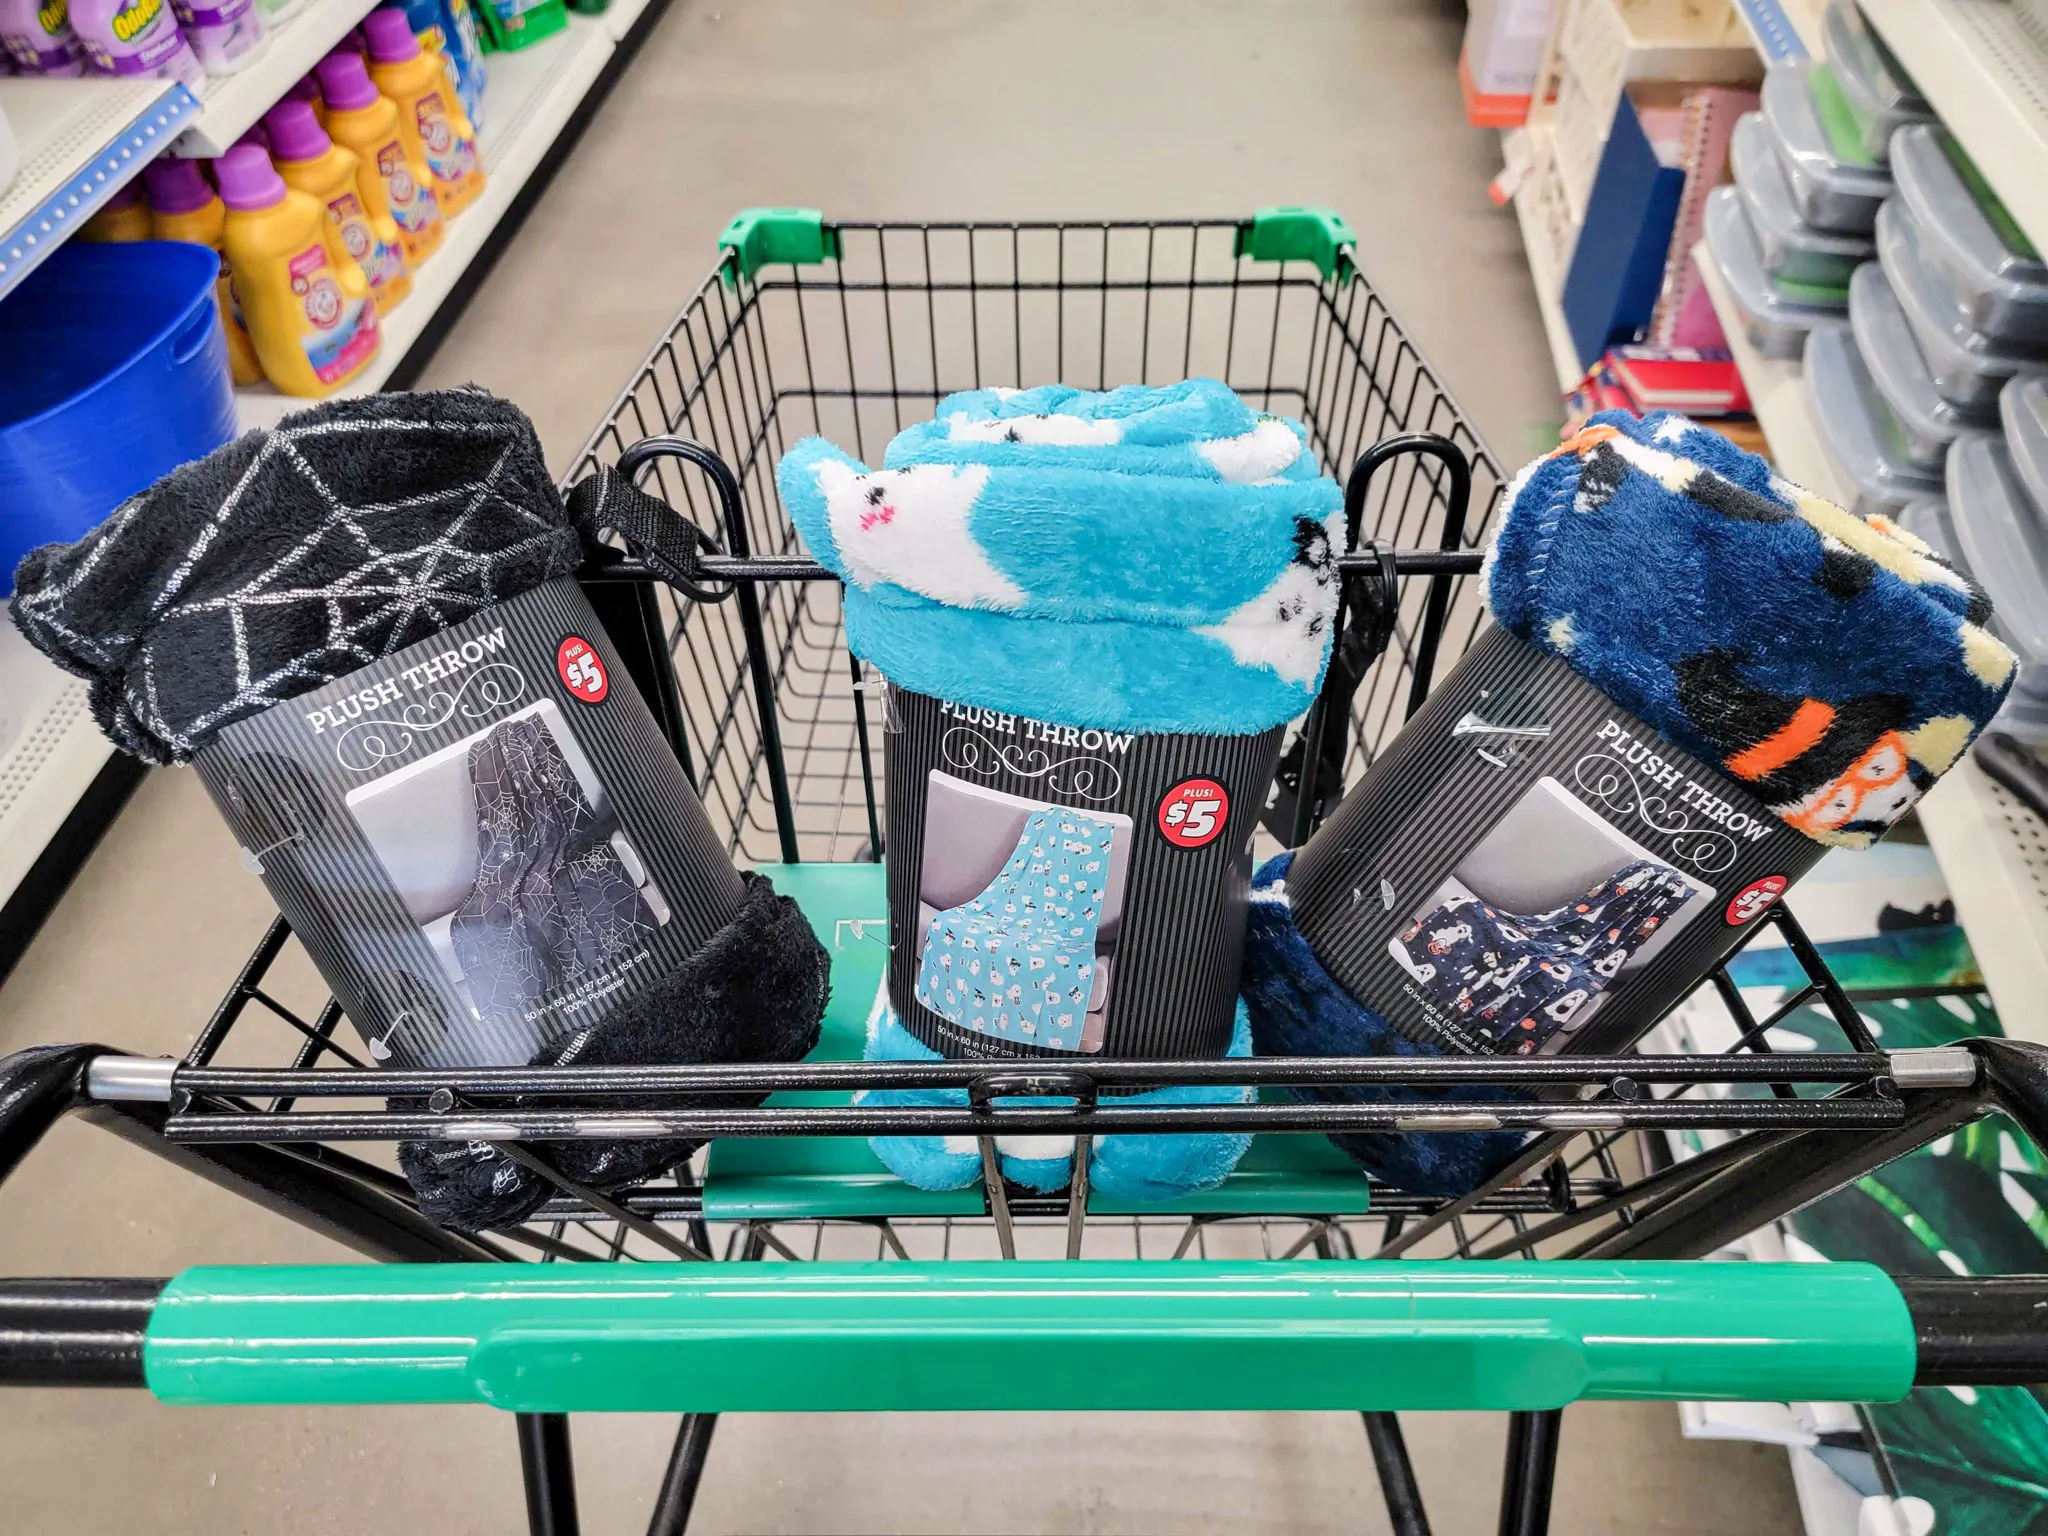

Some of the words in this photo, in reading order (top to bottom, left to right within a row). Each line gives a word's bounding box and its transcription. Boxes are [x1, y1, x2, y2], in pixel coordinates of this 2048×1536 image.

[565, 643, 584, 659] PLUS!
[305, 677, 404, 735] PLUSH
[401, 626, 509, 691] THROW
[566, 651, 603, 693] $5
[940, 699, 1017, 735] PLUSH
[1023, 717, 1135, 754] THROW
[1182, 788, 1214, 798] PLUS!
[1596, 719, 1684, 791] PLUSH
[1679, 780, 1773, 843] THROW
[1164, 799, 1222, 838] $5
[1735, 888, 1777, 919] $5
[524, 1011, 537, 1022] 50
[538, 1006, 547, 1016] in
[554, 996, 566, 1008] 60
[567, 992, 576, 1001] in
[575, 980, 594, 997] (127
[597, 974, 611, 985] cm
[611, 969, 618, 977] x
[618, 959, 634, 973] 152
[634, 949, 650, 964] cm)
[563, 997, 588, 1015] 100%
[588, 978, 625, 1002] Polyester
[1403, 983, 1414, 995] 50
[1413, 993, 1421, 1001] in
[1425, 1003, 1437, 1015] 60
[1436, 1013, 1444, 1021] in
[1442, 1018, 1461, 1034] (127
[1460, 1032, 1473, 1043] cm
[1480, 1045, 1494, 1055] 152
[1422, 1013, 1443, 1032] 100%
[1442, 1029, 1476, 1055] Polyester
[937, 1024, 947, 1035] 50
[946, 1029, 954, 1039] in
[960, 1036, 971, 1046] 60
[972, 1040, 980, 1049] in
[981, 1043, 1000, 1054] (127
[1001, 1049, 1015, 1058] cm
[963, 1047, 985, 1060] 100%
